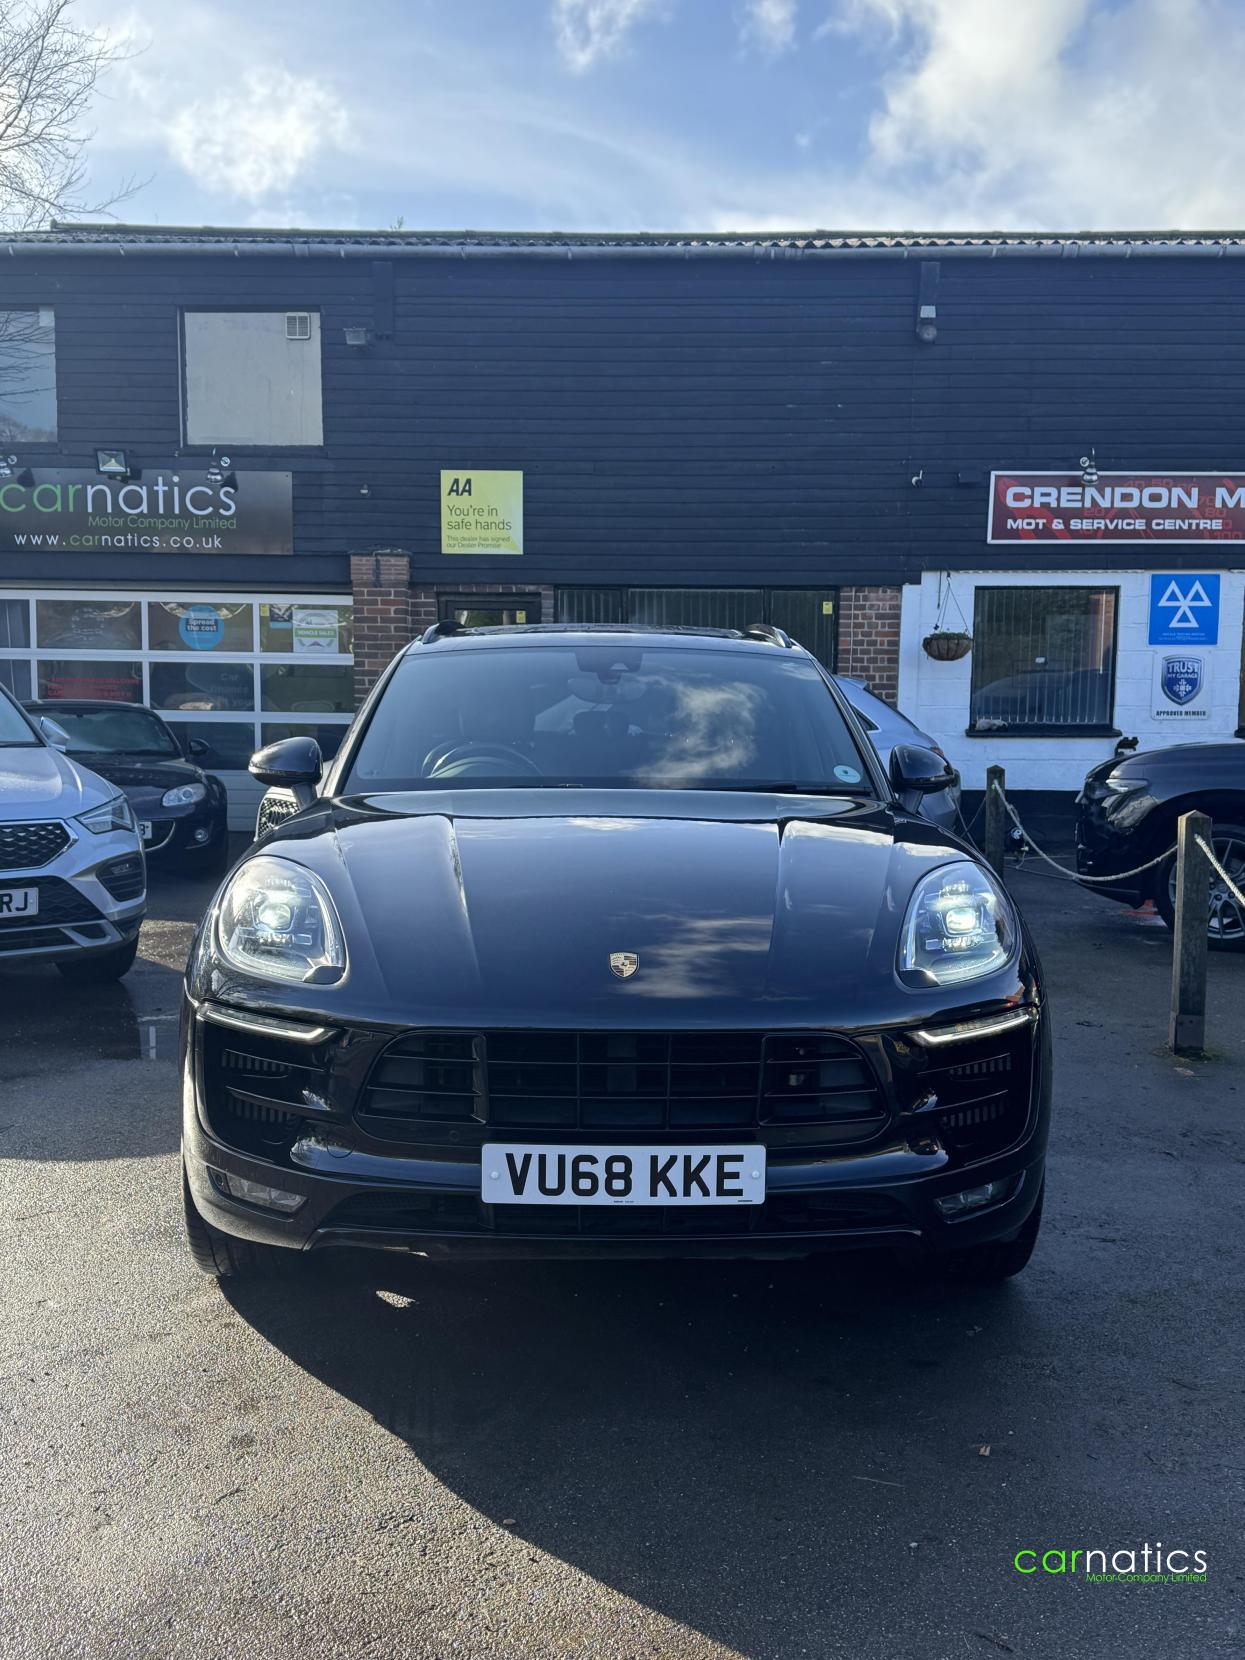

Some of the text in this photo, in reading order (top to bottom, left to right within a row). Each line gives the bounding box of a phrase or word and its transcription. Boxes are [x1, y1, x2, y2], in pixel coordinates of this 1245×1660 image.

[447, 477, 472, 496] AA
[0, 475, 236, 516] carnatics
[1005, 486, 1198, 509] CRENDON
[447, 504, 498, 517] You're in
[88, 515, 237, 530] Motor Company Limited
[447, 518, 512, 531] safe hands
[1006, 518, 1223, 530] MOT & SERVICE CENTRE
[14, 532, 222, 548] www.carnatics.co.uk
[188, 618, 215, 626] Spread
[1167, 661, 1199, 673] TRUST
[0, 891, 28, 913] RJ
[505, 1152, 744, 1198] VU68 KKE
